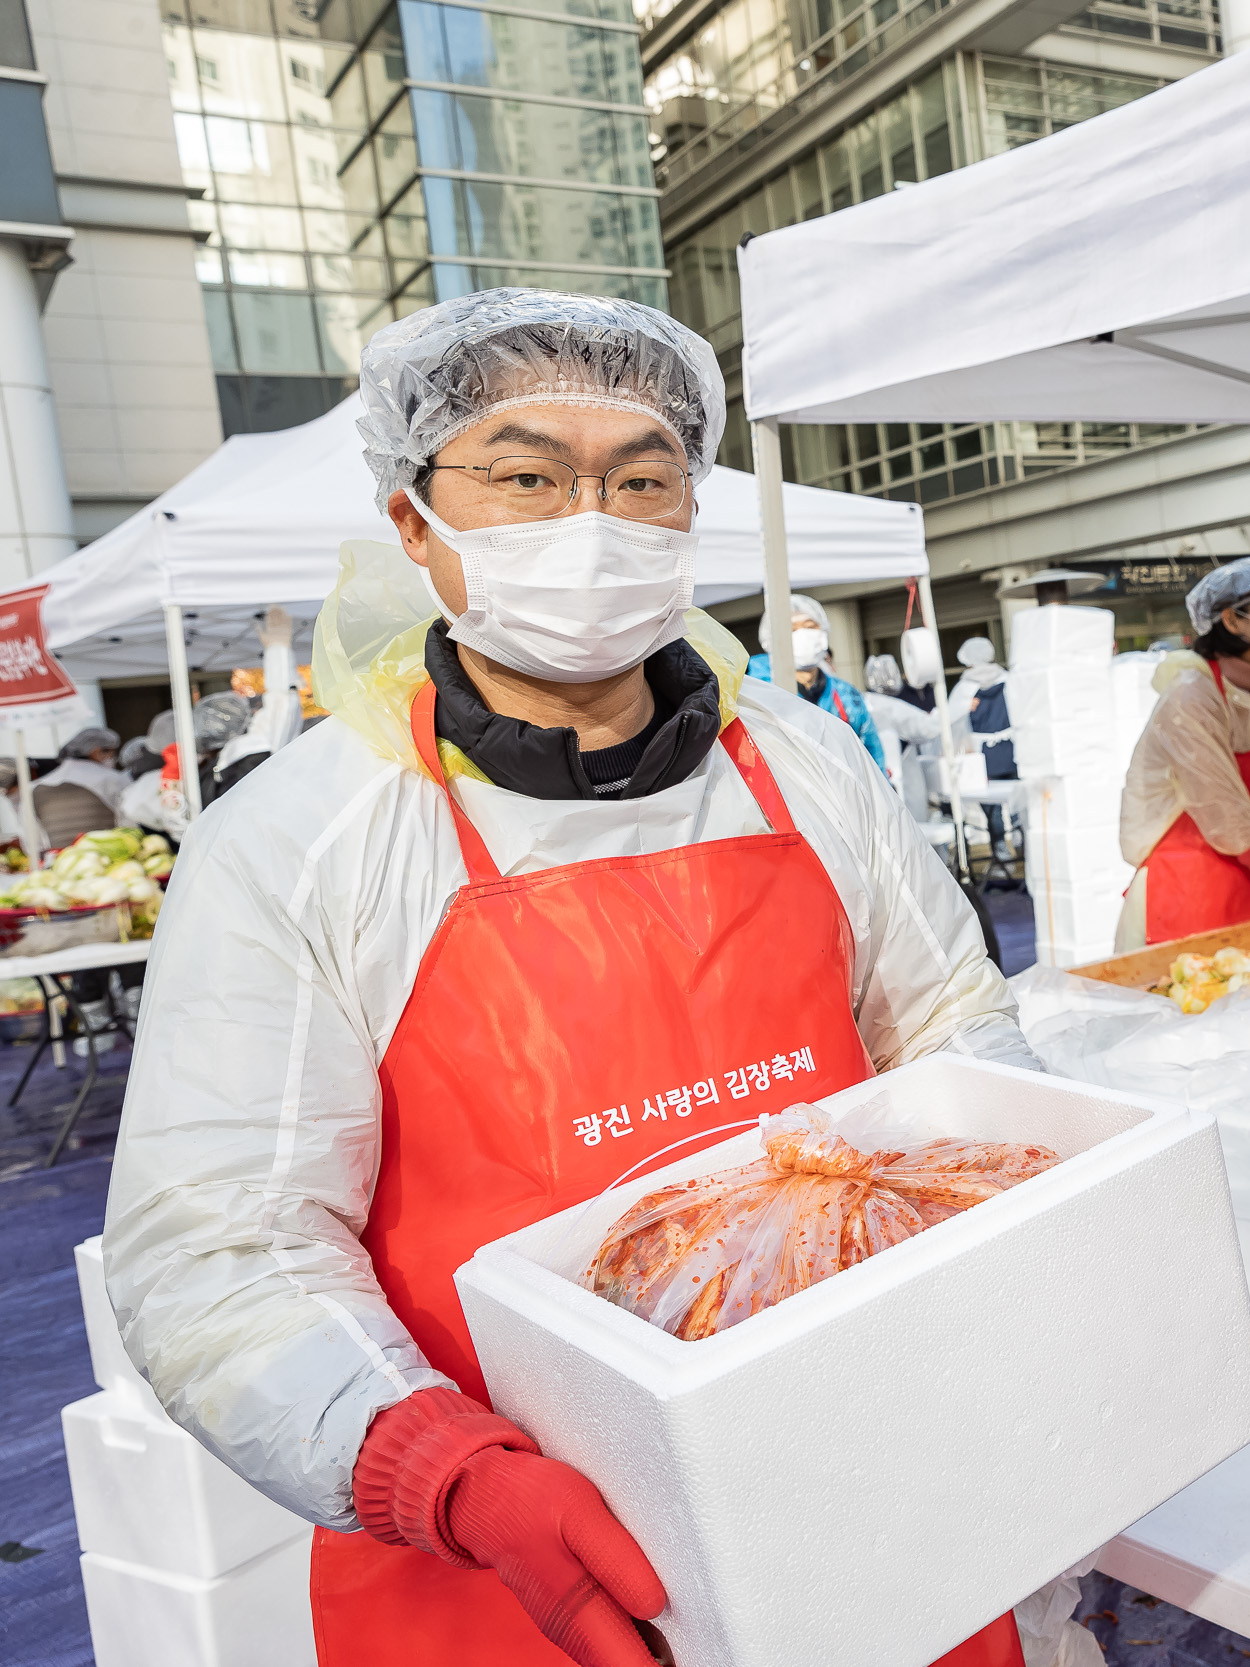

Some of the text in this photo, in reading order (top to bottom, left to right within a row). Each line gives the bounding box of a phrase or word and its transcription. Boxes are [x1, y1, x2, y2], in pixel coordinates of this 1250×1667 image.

[572, 1046, 816, 1146] 광진 사랑의 김장축제
